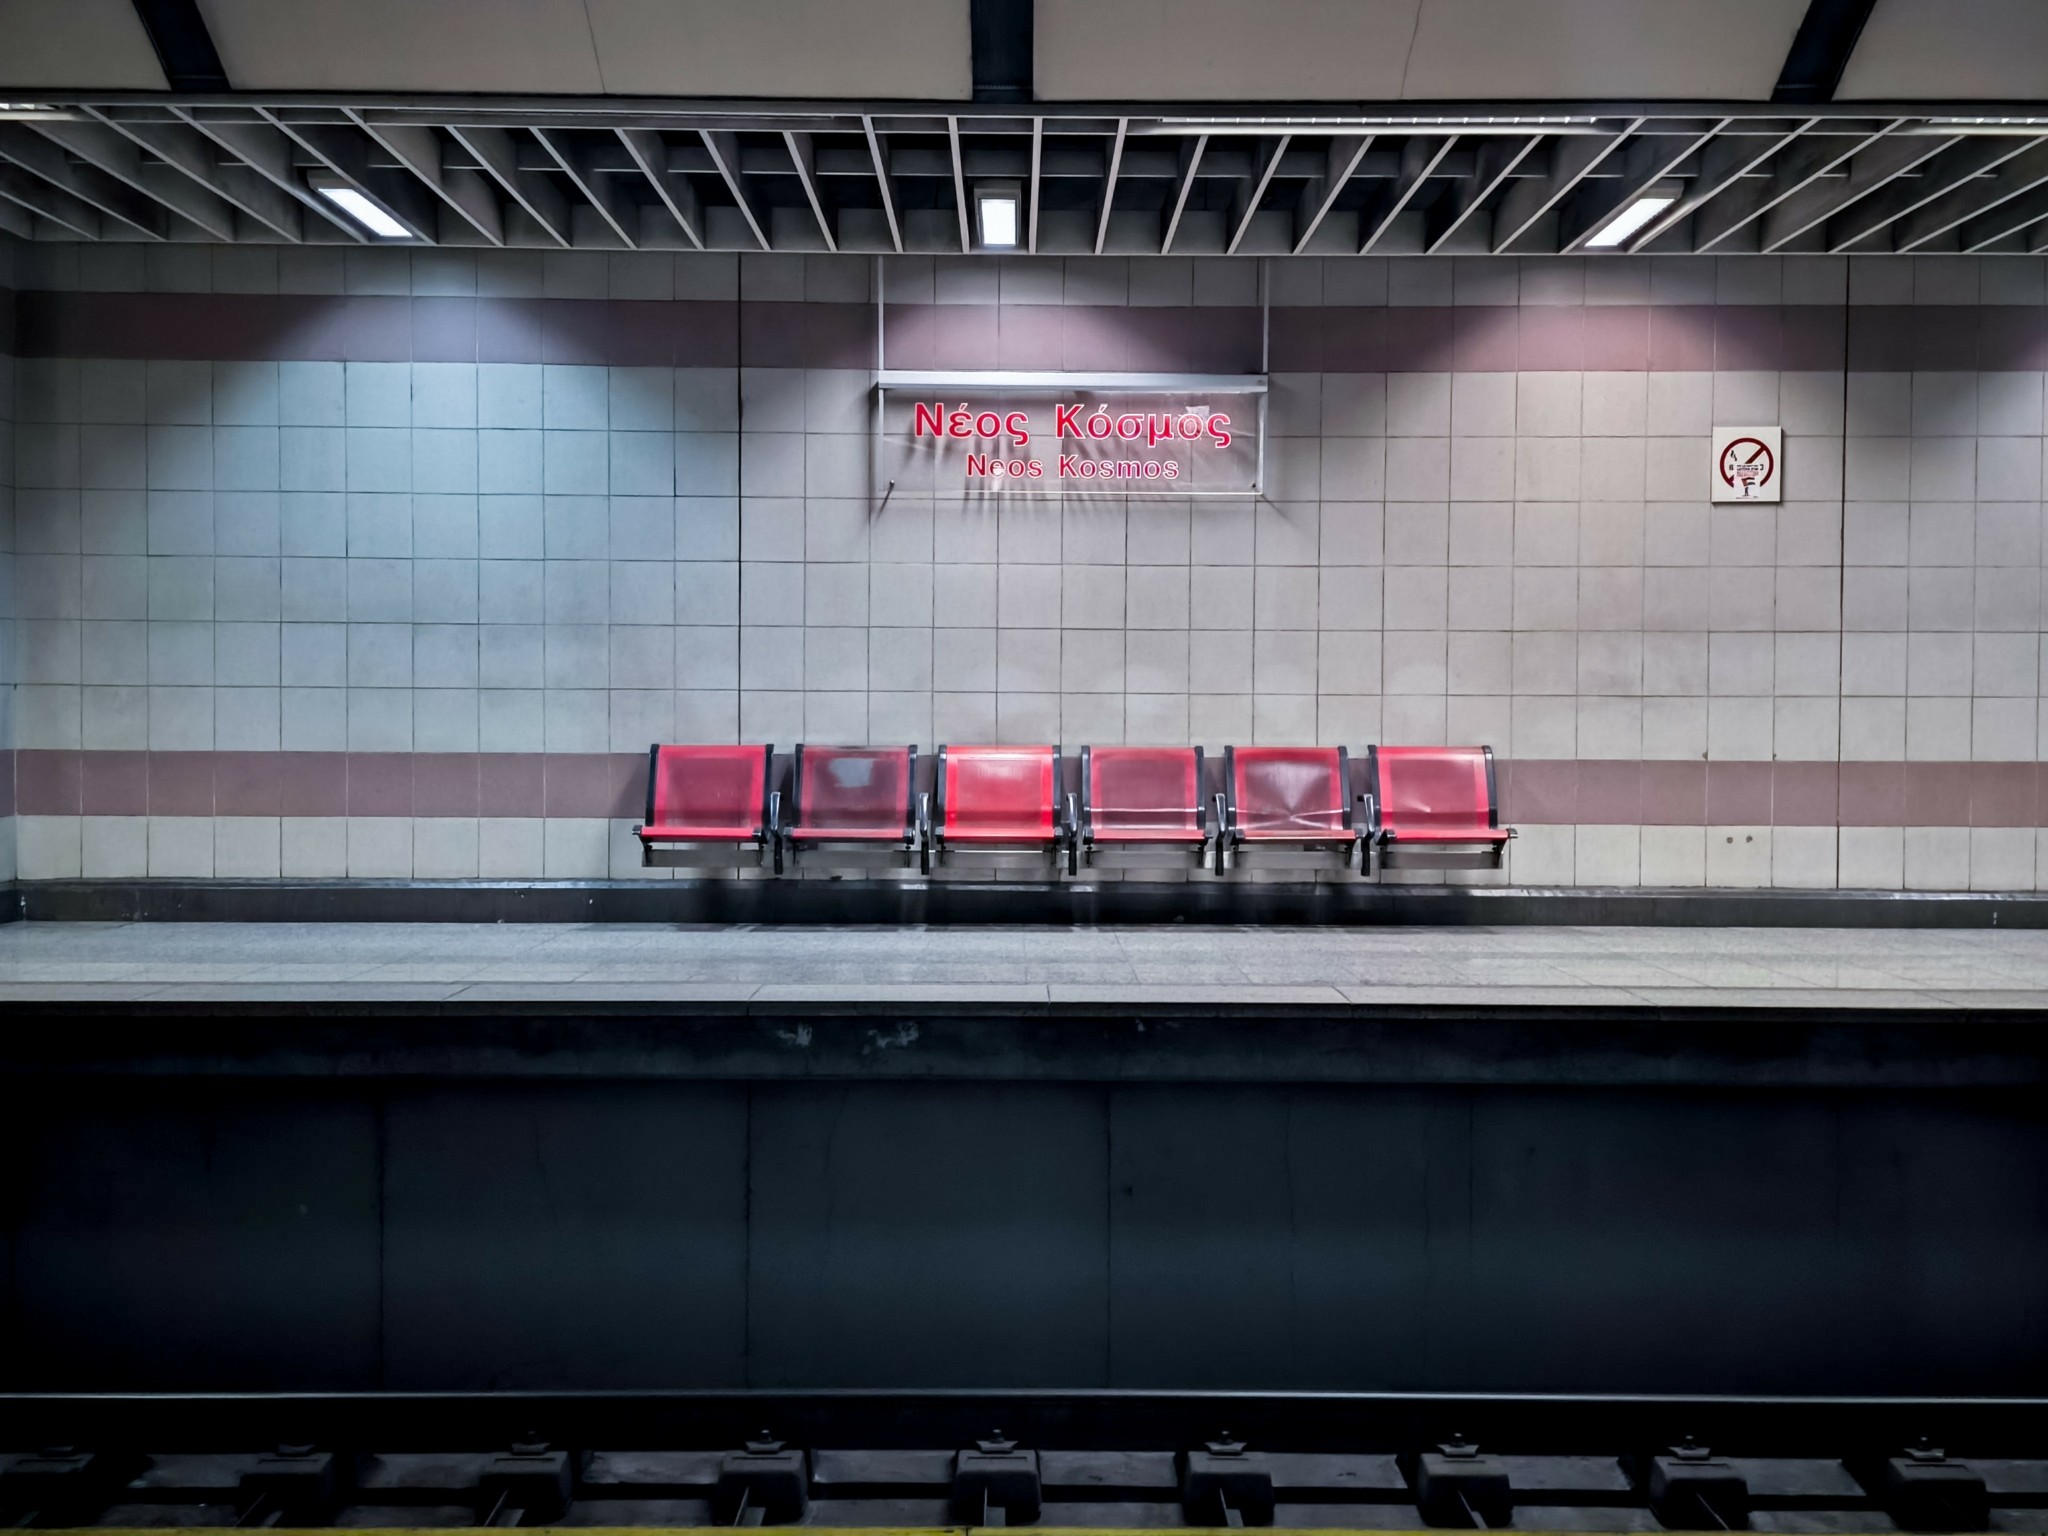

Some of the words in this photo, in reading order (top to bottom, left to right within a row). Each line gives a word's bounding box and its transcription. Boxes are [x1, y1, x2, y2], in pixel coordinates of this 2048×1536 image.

[914, 402, 1029, 445] Νέος
[1054, 403, 1233, 448] Κόσμος
[966, 453, 1044, 478] Neos
[1058, 454, 1180, 480] Kosmos
